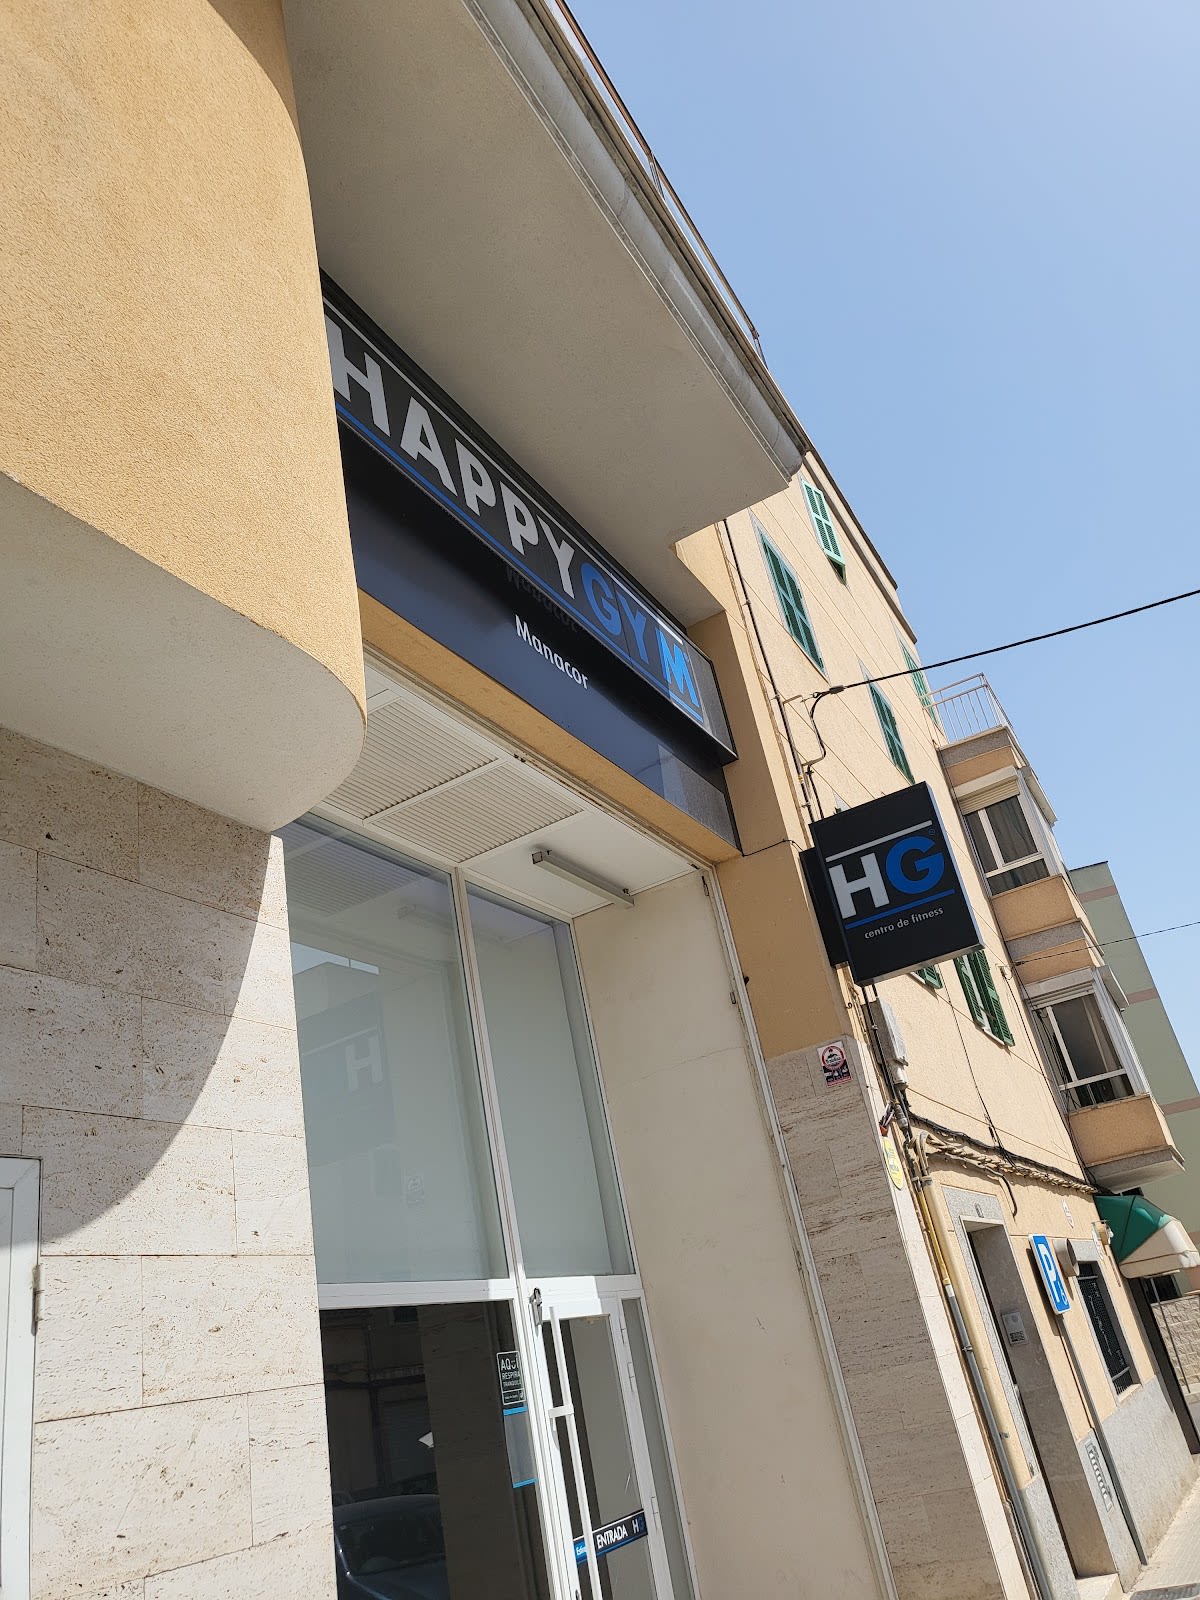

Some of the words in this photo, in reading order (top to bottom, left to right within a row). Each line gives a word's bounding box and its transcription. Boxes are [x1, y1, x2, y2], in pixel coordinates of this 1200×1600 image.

[515, 614, 588, 689] Manacor
[828, 835, 945, 919] HG
[864, 924, 895, 939] centro
[897, 918, 910, 929] de
[911, 907, 944, 923] fitness
[1037, 1243, 1061, 1303] P
[596, 1524, 628, 1549] ENTRADA
